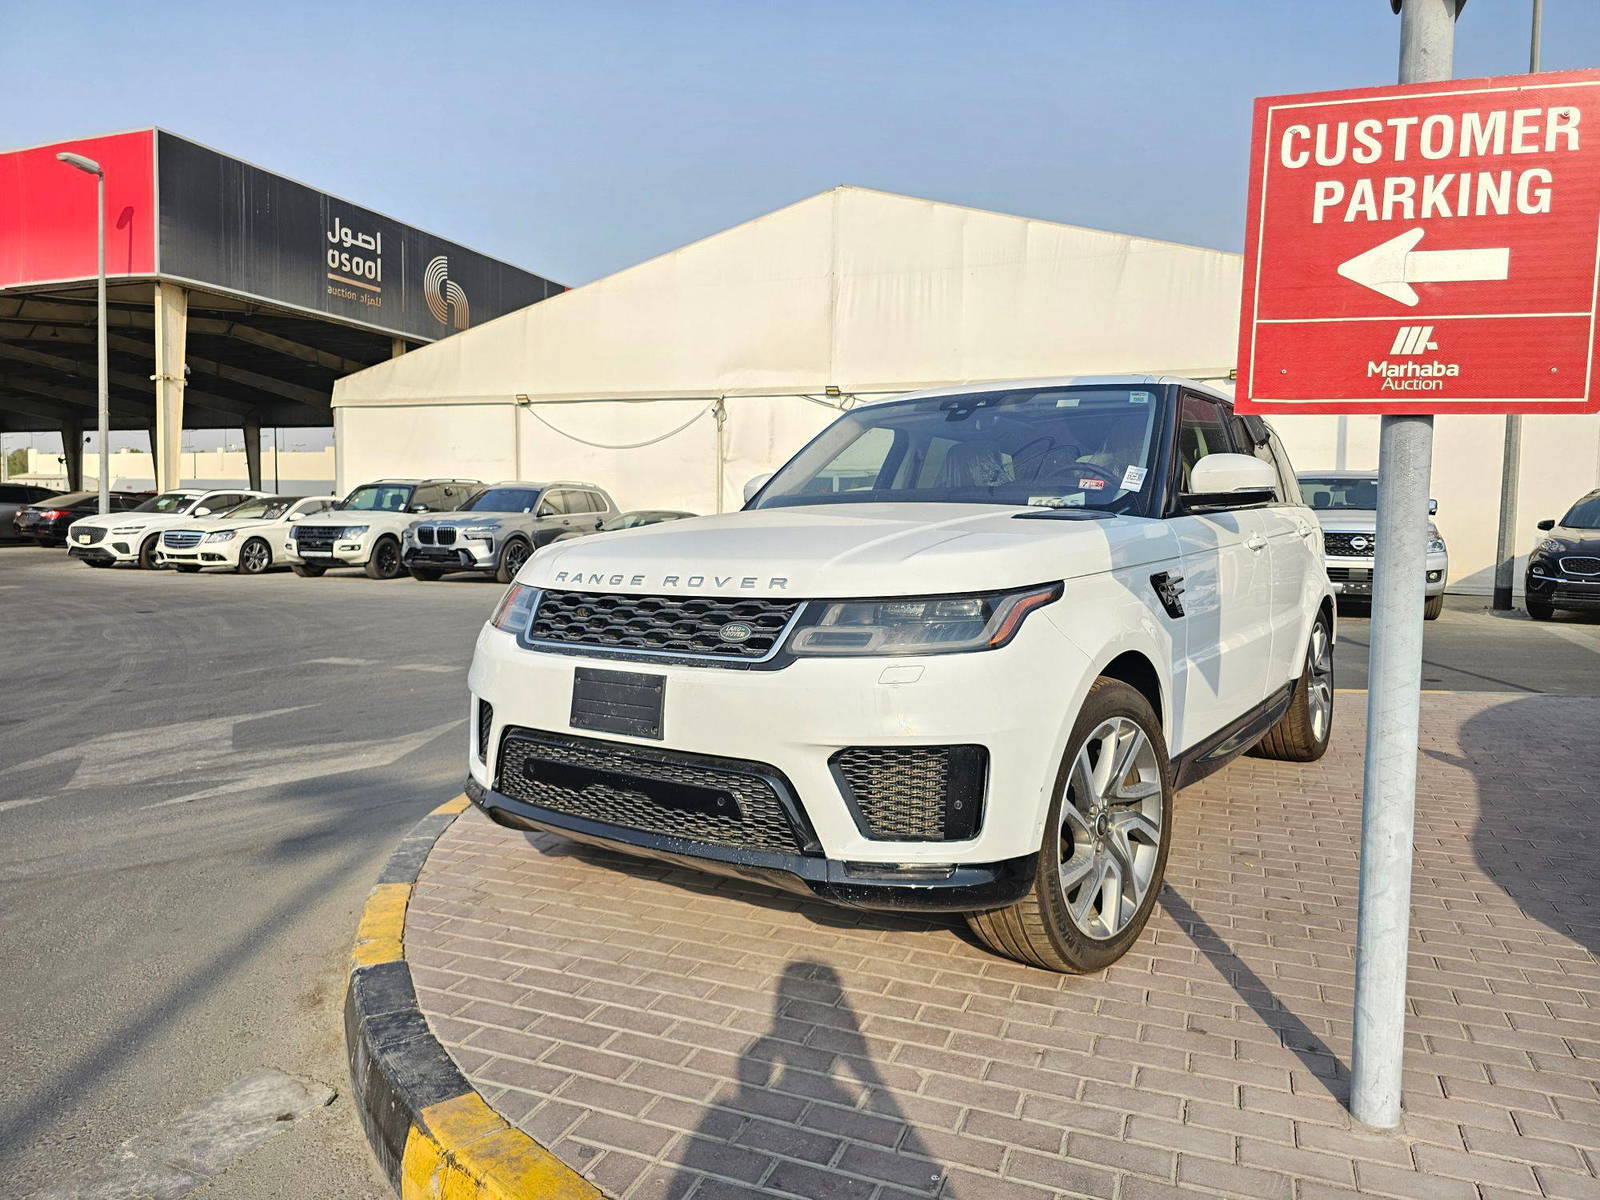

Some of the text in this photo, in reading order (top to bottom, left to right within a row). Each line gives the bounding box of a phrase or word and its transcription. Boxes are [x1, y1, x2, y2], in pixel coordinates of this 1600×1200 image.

[1280, 106, 1582, 169] CUSTOMER
[1312, 168, 1553, 224] PARKING
[327, 217, 382, 255] اصول
[327, 248, 382, 282] osool
[328, 285, 357, 301] auction
[1367, 360, 1460, 378] Marhaba
[1381, 378, 1443, 391] Auction
[555, 571, 789, 590] RANGE ROVER
